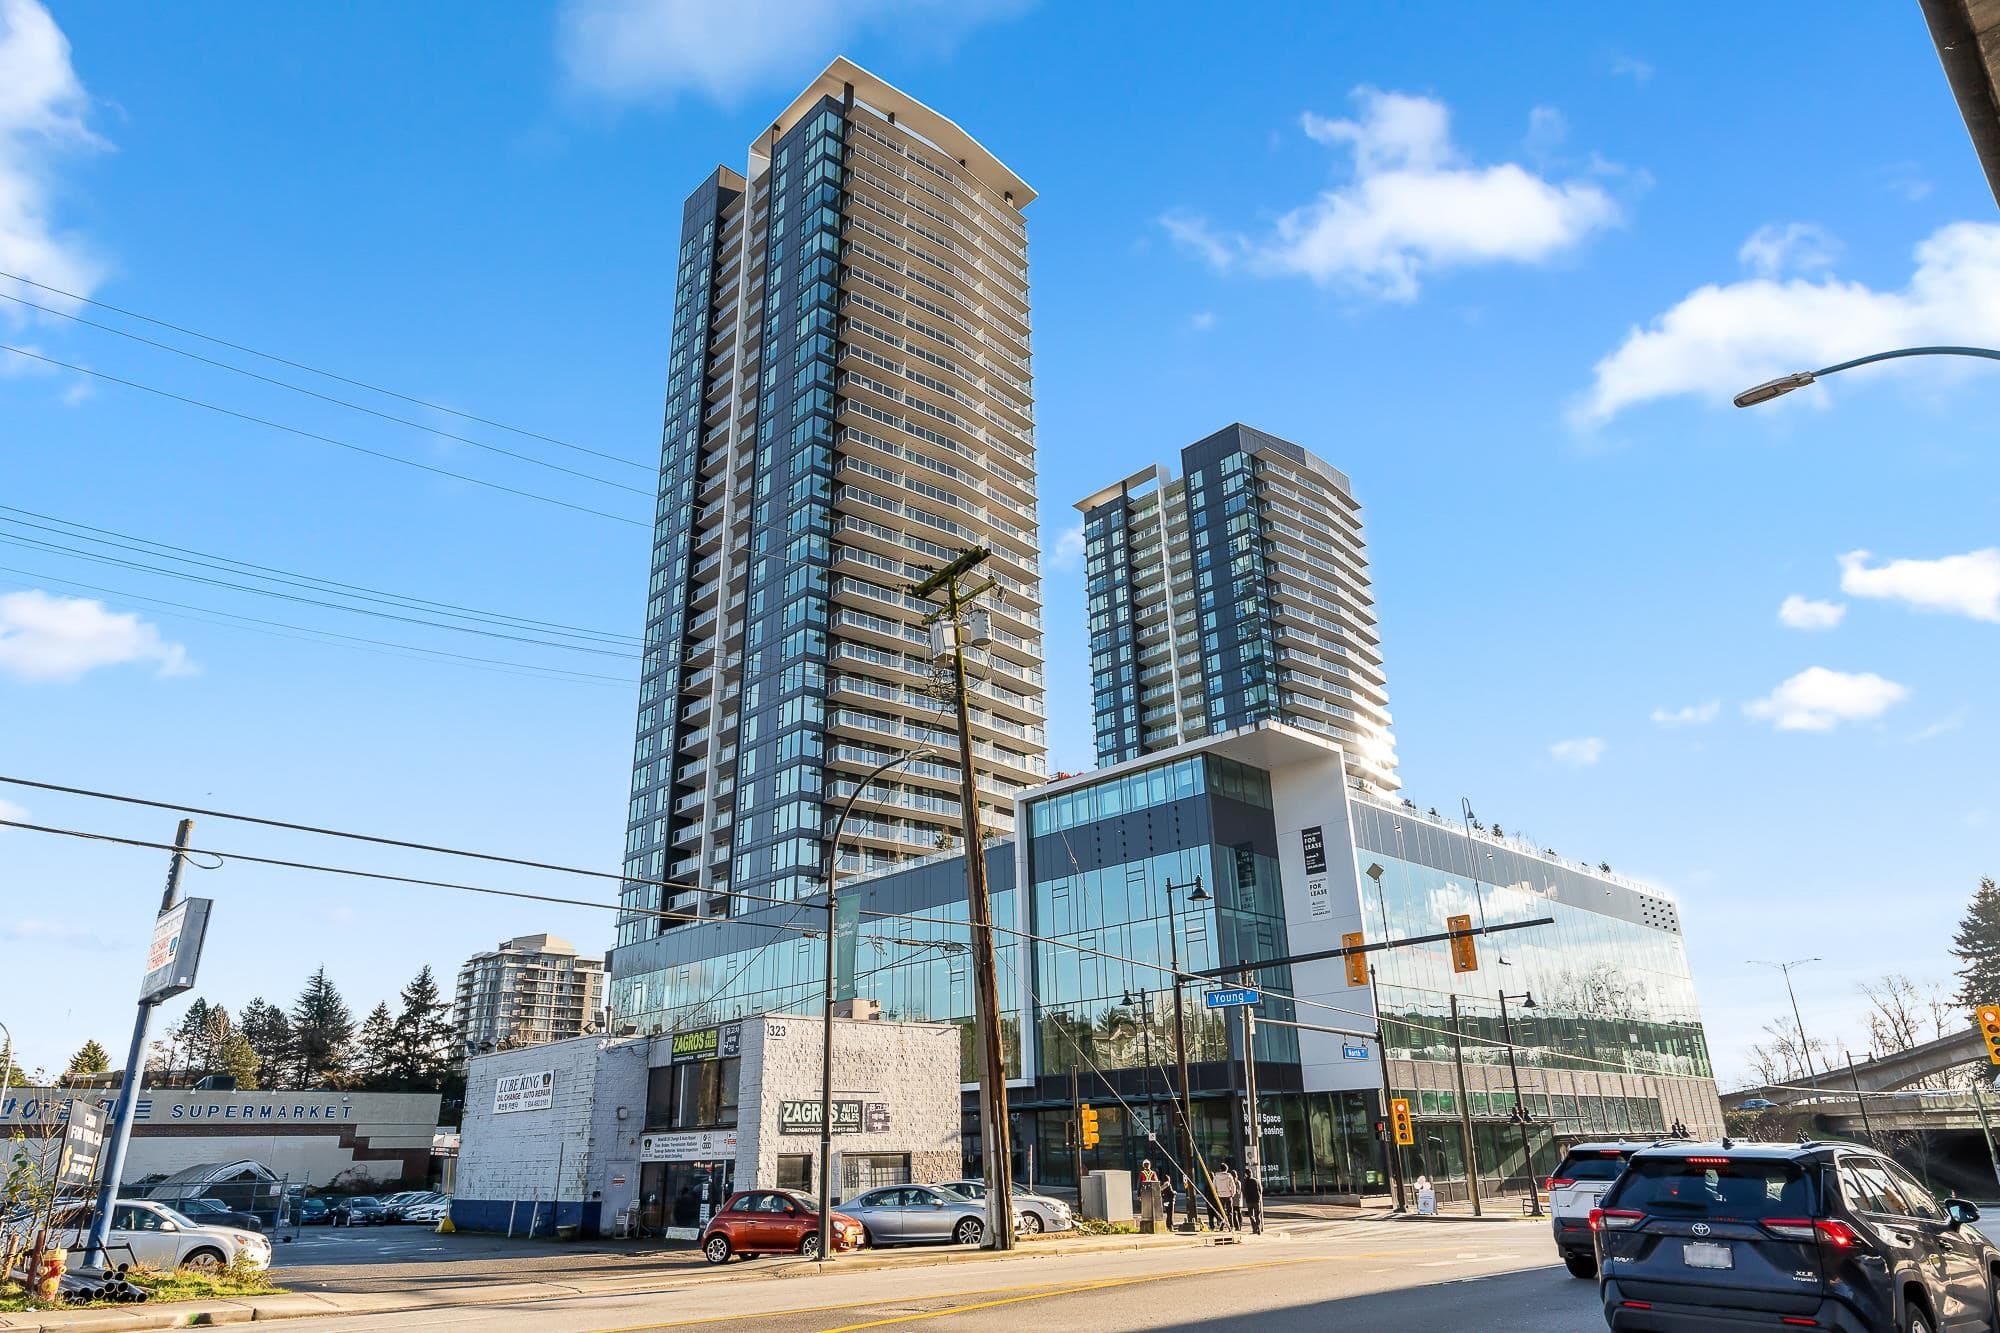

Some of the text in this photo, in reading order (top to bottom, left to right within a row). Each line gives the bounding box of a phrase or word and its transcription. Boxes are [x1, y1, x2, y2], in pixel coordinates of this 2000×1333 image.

[1304, 836, 1316, 844] FOR
[1305, 842, 1322, 851] LEASE
[1309, 883, 1321, 891] FOR
[1310, 888, 1328, 897] LEASE
[1214, 992, 1244, 1003] Young
[672, 1031, 705, 1054] ZAGROS
[499, 1075, 540, 1093] LUBE KING
[171, 1104, 353, 1120] SUPERMARKET
[782, 1102, 839, 1123] ZAGRS
[842, 1103, 859, 1113] AUTO
[840, 1112, 860, 1122] SALES
[1262, 1113, 1281, 1125] Space
